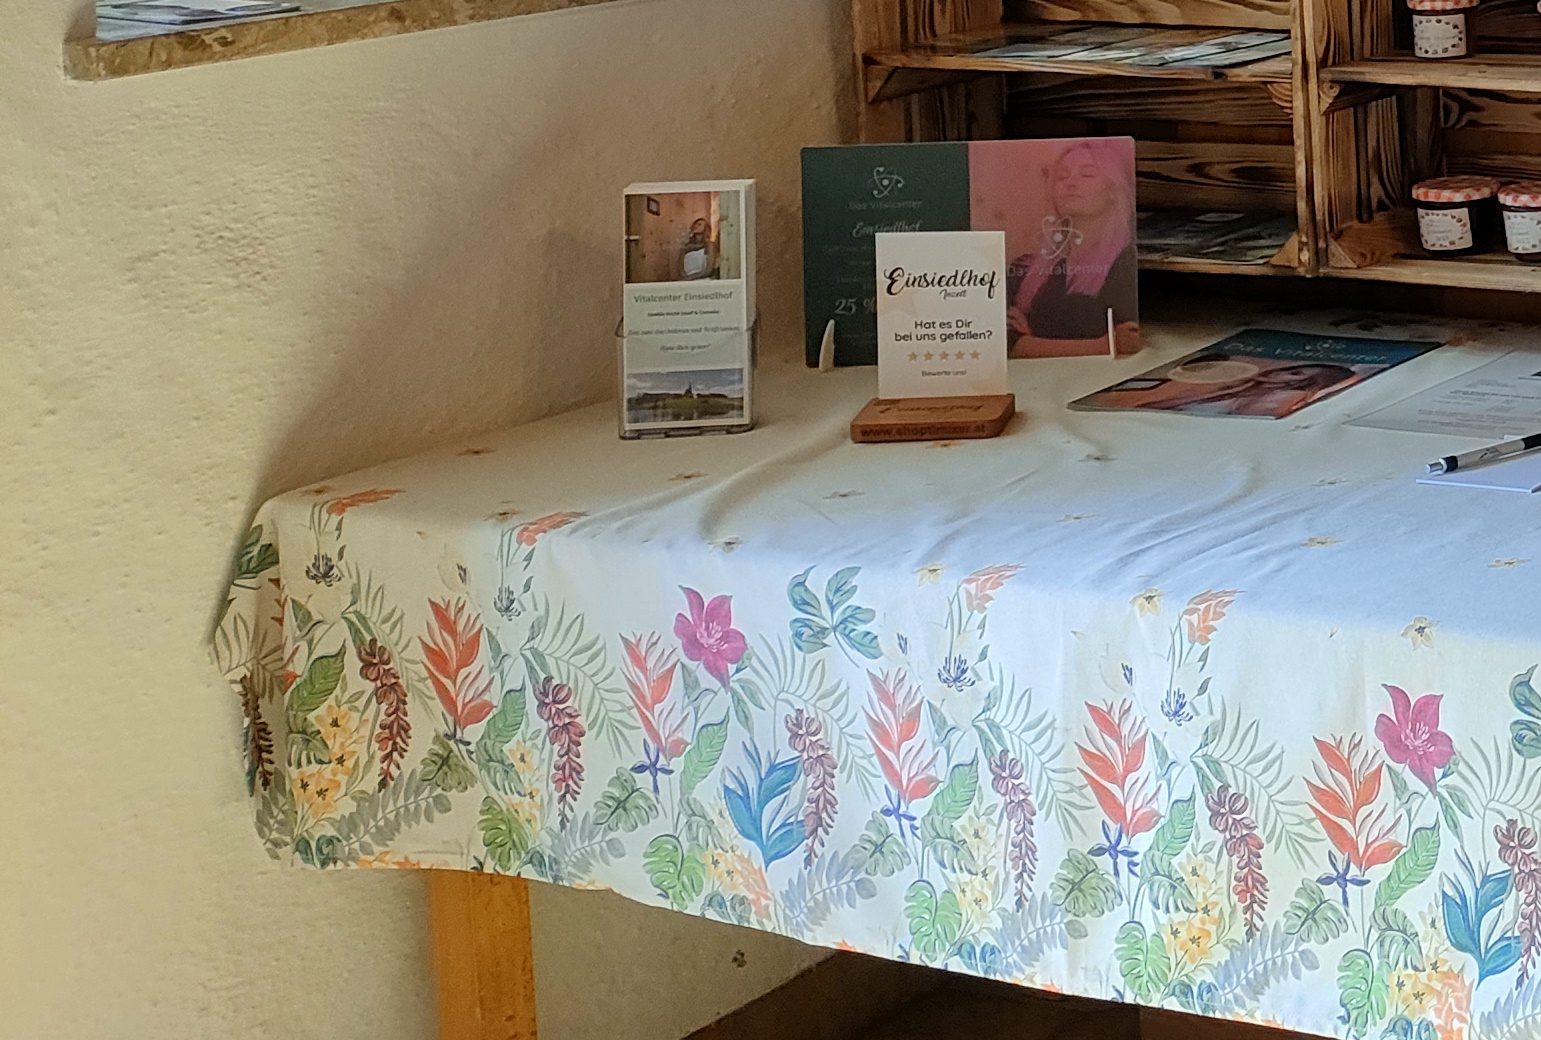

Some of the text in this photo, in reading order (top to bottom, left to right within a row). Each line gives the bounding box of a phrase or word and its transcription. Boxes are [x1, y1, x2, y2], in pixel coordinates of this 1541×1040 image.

[883, 266, 1000, 300] Einsiedlhof
[633, 291, 733, 303] Vitalcenter Einsiedlhof
[834, 298, 857, 316] 25
[914, 319, 973, 330] Hat es Dir
[894, 330, 993, 343] bei uns gefallen?
